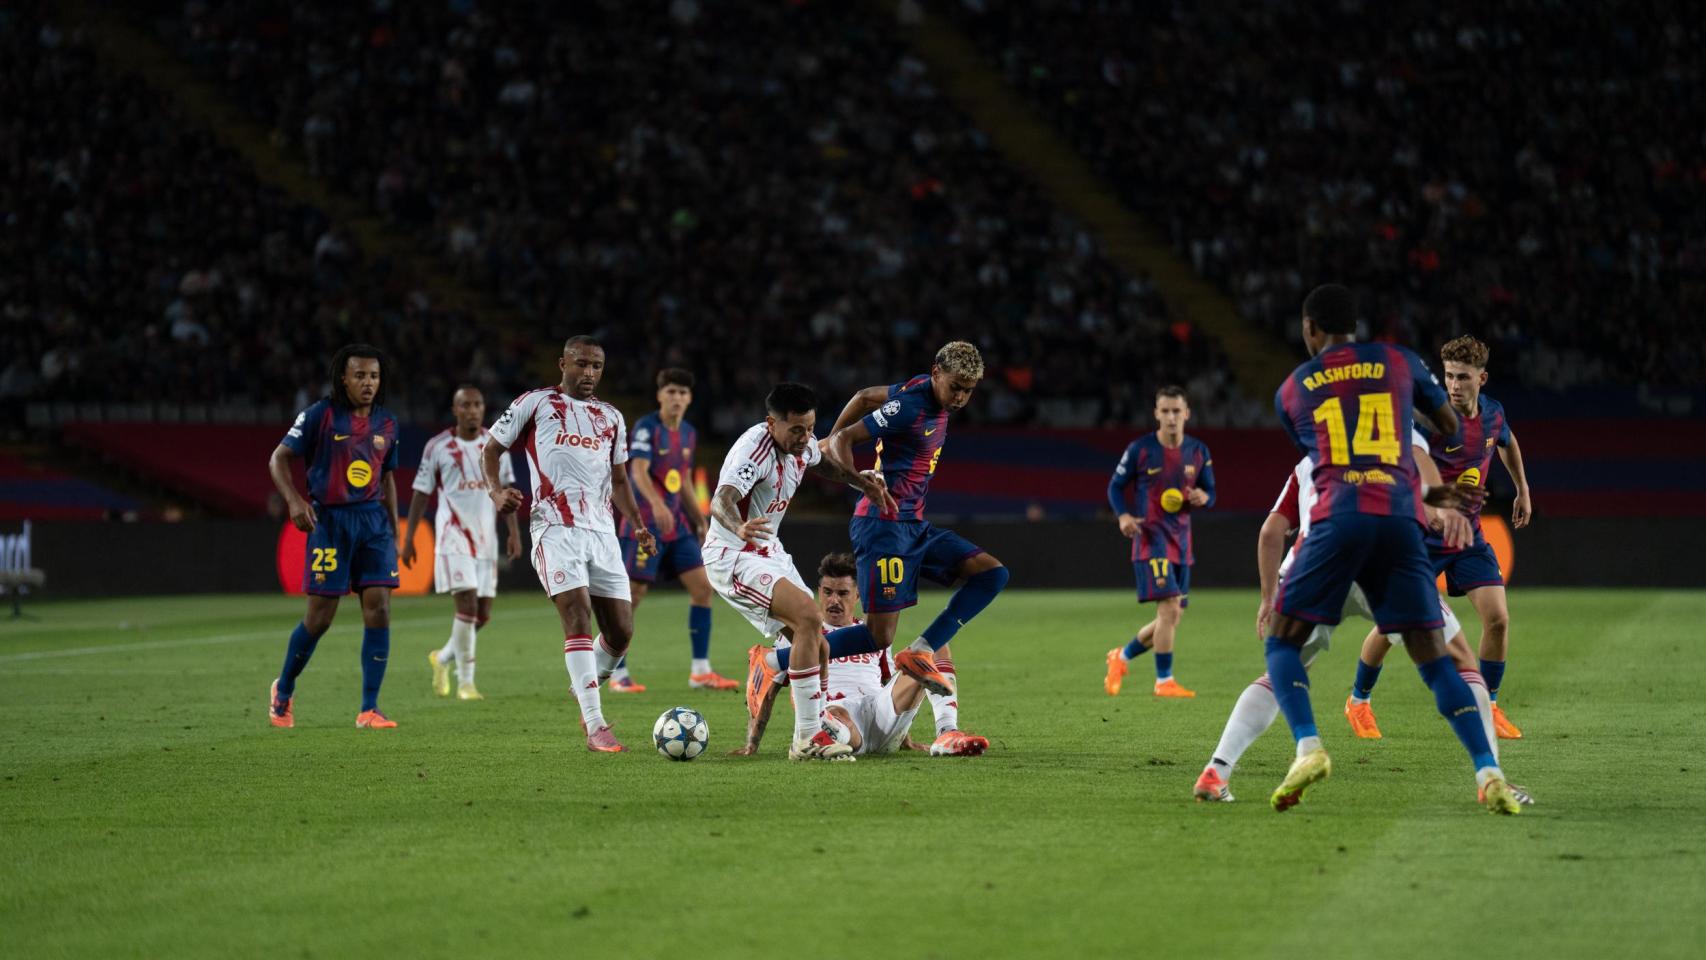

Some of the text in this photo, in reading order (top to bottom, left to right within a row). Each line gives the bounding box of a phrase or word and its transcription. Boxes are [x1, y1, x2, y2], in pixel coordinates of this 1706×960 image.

[1302, 362, 1385, 392] RASHFORD
[554, 430, 601, 450] iroes
[1312, 392, 1401, 466] 14
[459, 479, 486, 491] iroe
[765, 499, 787, 514] iro
[0, 519, 32, 574] rd
[311, 547, 338, 572] 23
[876, 556, 904, 584] 10
[1148, 558, 1169, 577] 17
